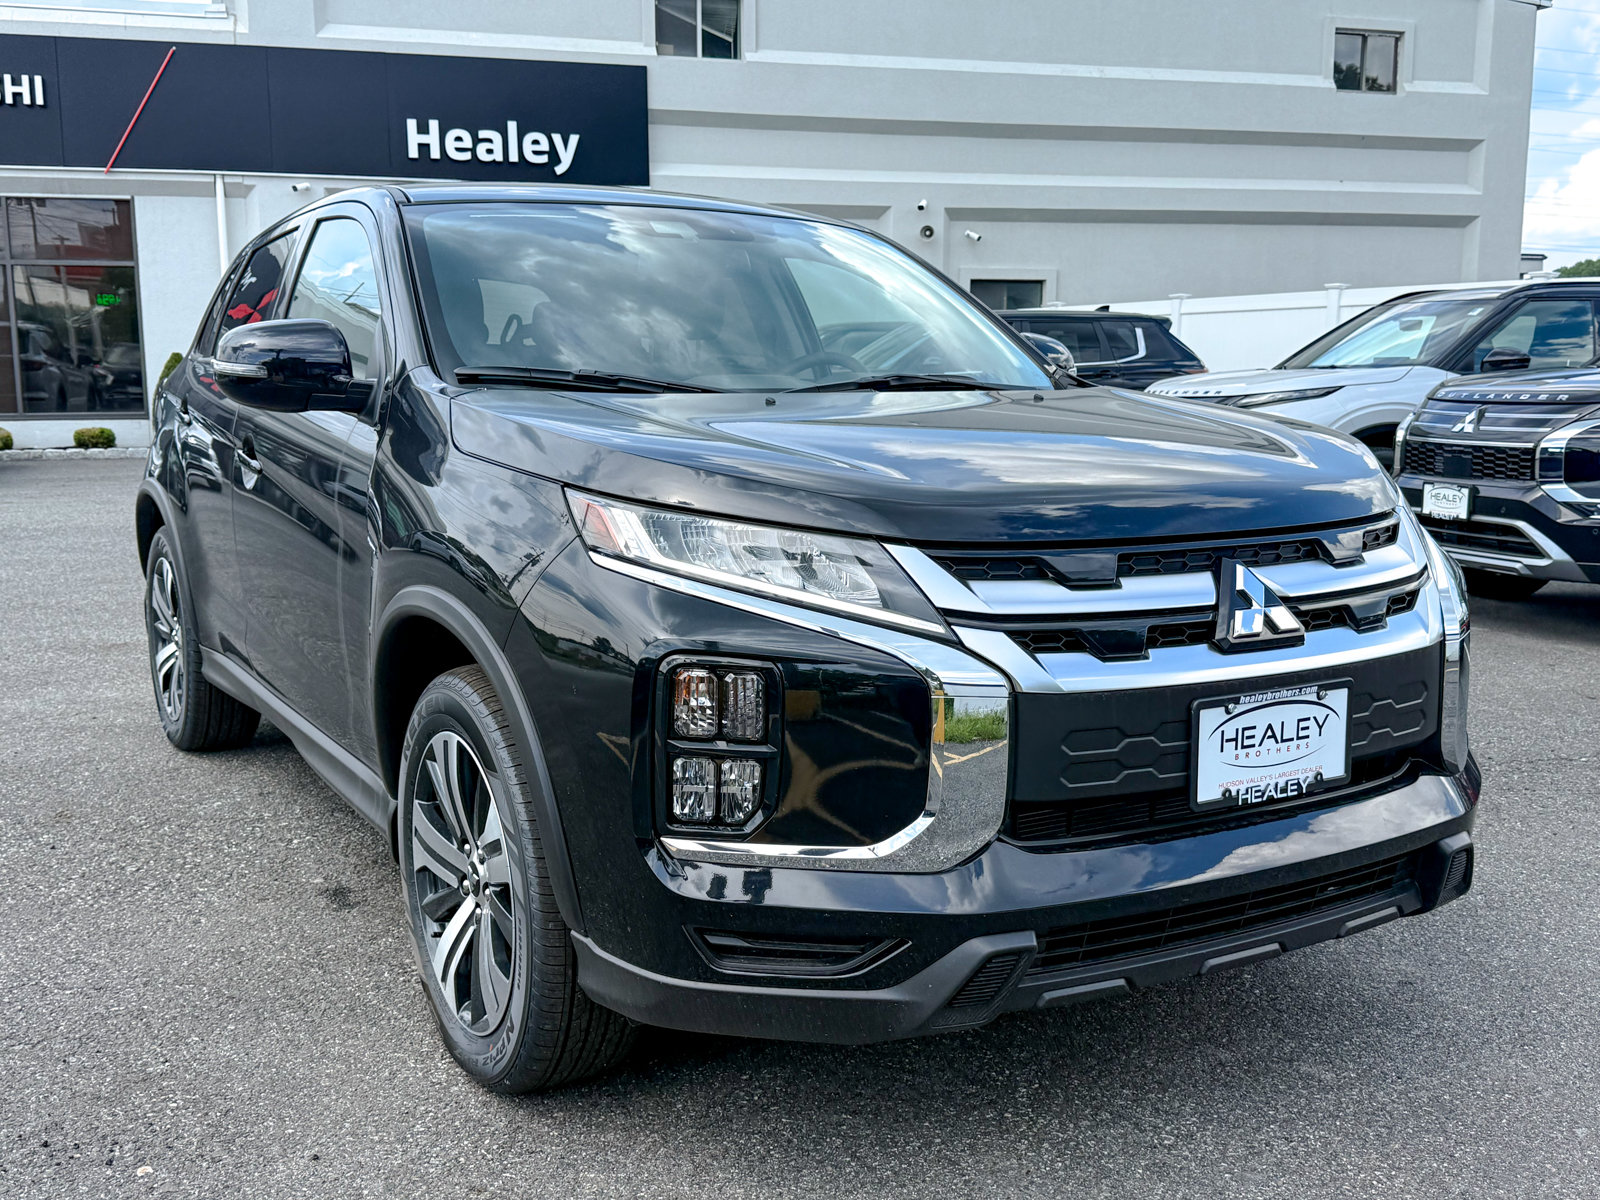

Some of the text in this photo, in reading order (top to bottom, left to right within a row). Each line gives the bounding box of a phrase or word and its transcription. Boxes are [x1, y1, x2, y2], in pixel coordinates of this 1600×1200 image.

[0, 73, 45, 106] HI
[406, 118, 581, 176] Healey
[1437, 391, 1570, 401] OUTLANDER
[1430, 492, 1464, 503] HEALEY
[1239, 686, 1318, 704] healeybrothers.com
[1220, 713, 1330, 753] HEALEY
[1234, 742, 1310, 761] BROTHERS
[1218, 765, 1323, 789] HUDSON VALLEY'S LARGEST DEALER
[1237, 777, 1310, 806] HEALEY
